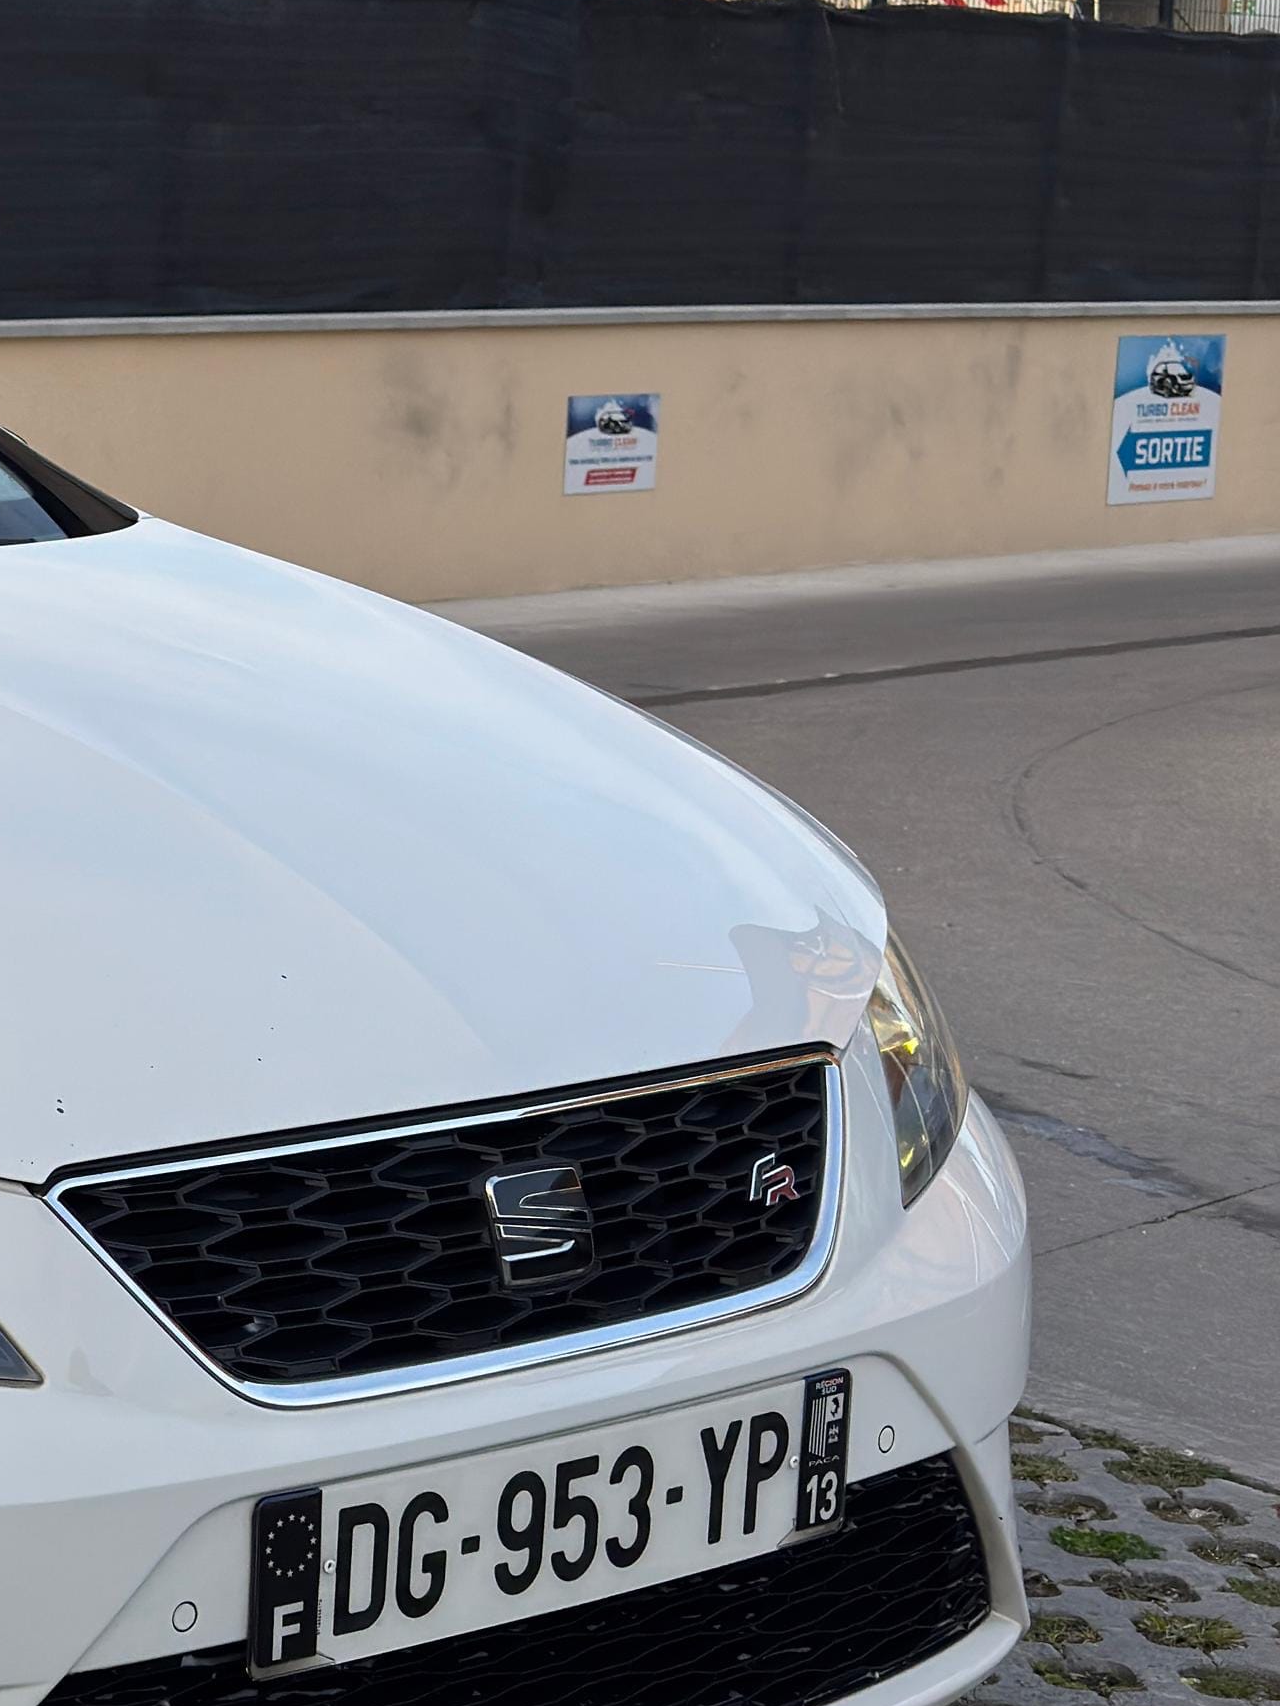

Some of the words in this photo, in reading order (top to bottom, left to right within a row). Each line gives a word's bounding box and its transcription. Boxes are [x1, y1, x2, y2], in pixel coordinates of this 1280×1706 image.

[1135, 436, 1204, 465] SORTIE
[748, 1152, 798, 1207] FR
[809, 1455, 839, 1468] PACA
[332, 1411, 790, 1636] DG-953-YP
[806, 1470, 838, 1524] 13
[271, 1600, 305, 1661] F
